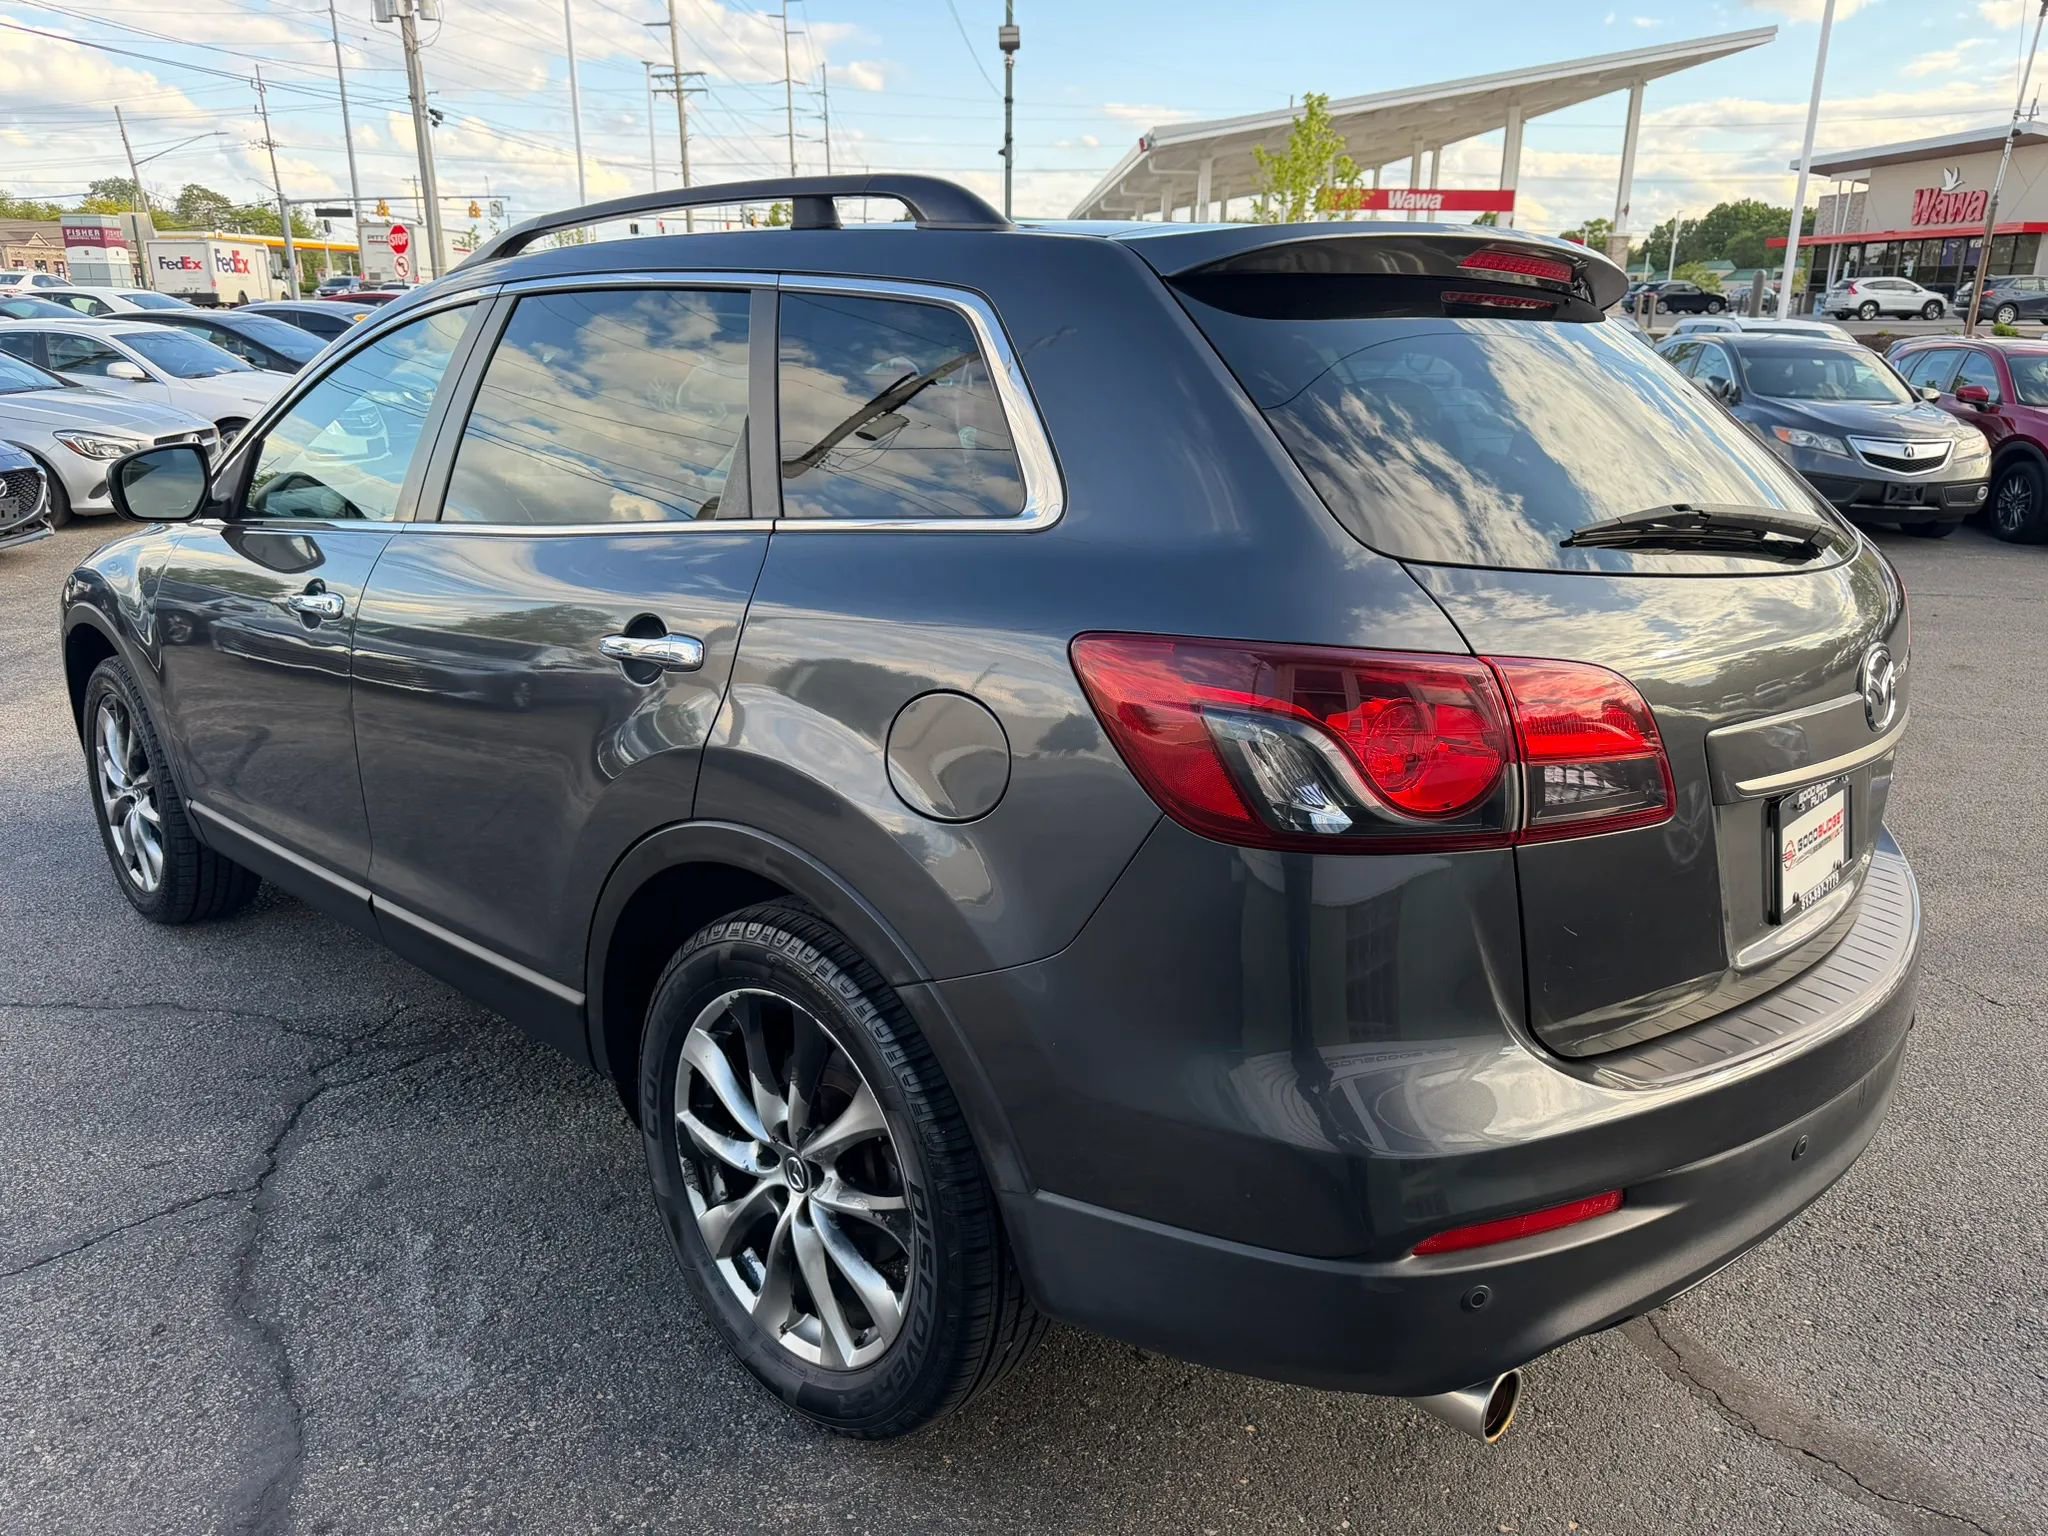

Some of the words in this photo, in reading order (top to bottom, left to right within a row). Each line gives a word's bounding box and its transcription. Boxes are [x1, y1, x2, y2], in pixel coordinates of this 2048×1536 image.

[1387, 190, 1444, 209] Wawa
[1912, 188, 1988, 225] Wawa
[66, 228, 101, 236] FISHER
[390, 233, 408, 246] STOP
[158, 256, 203, 270] FedEx
[214, 248, 251, 274] FedEx
